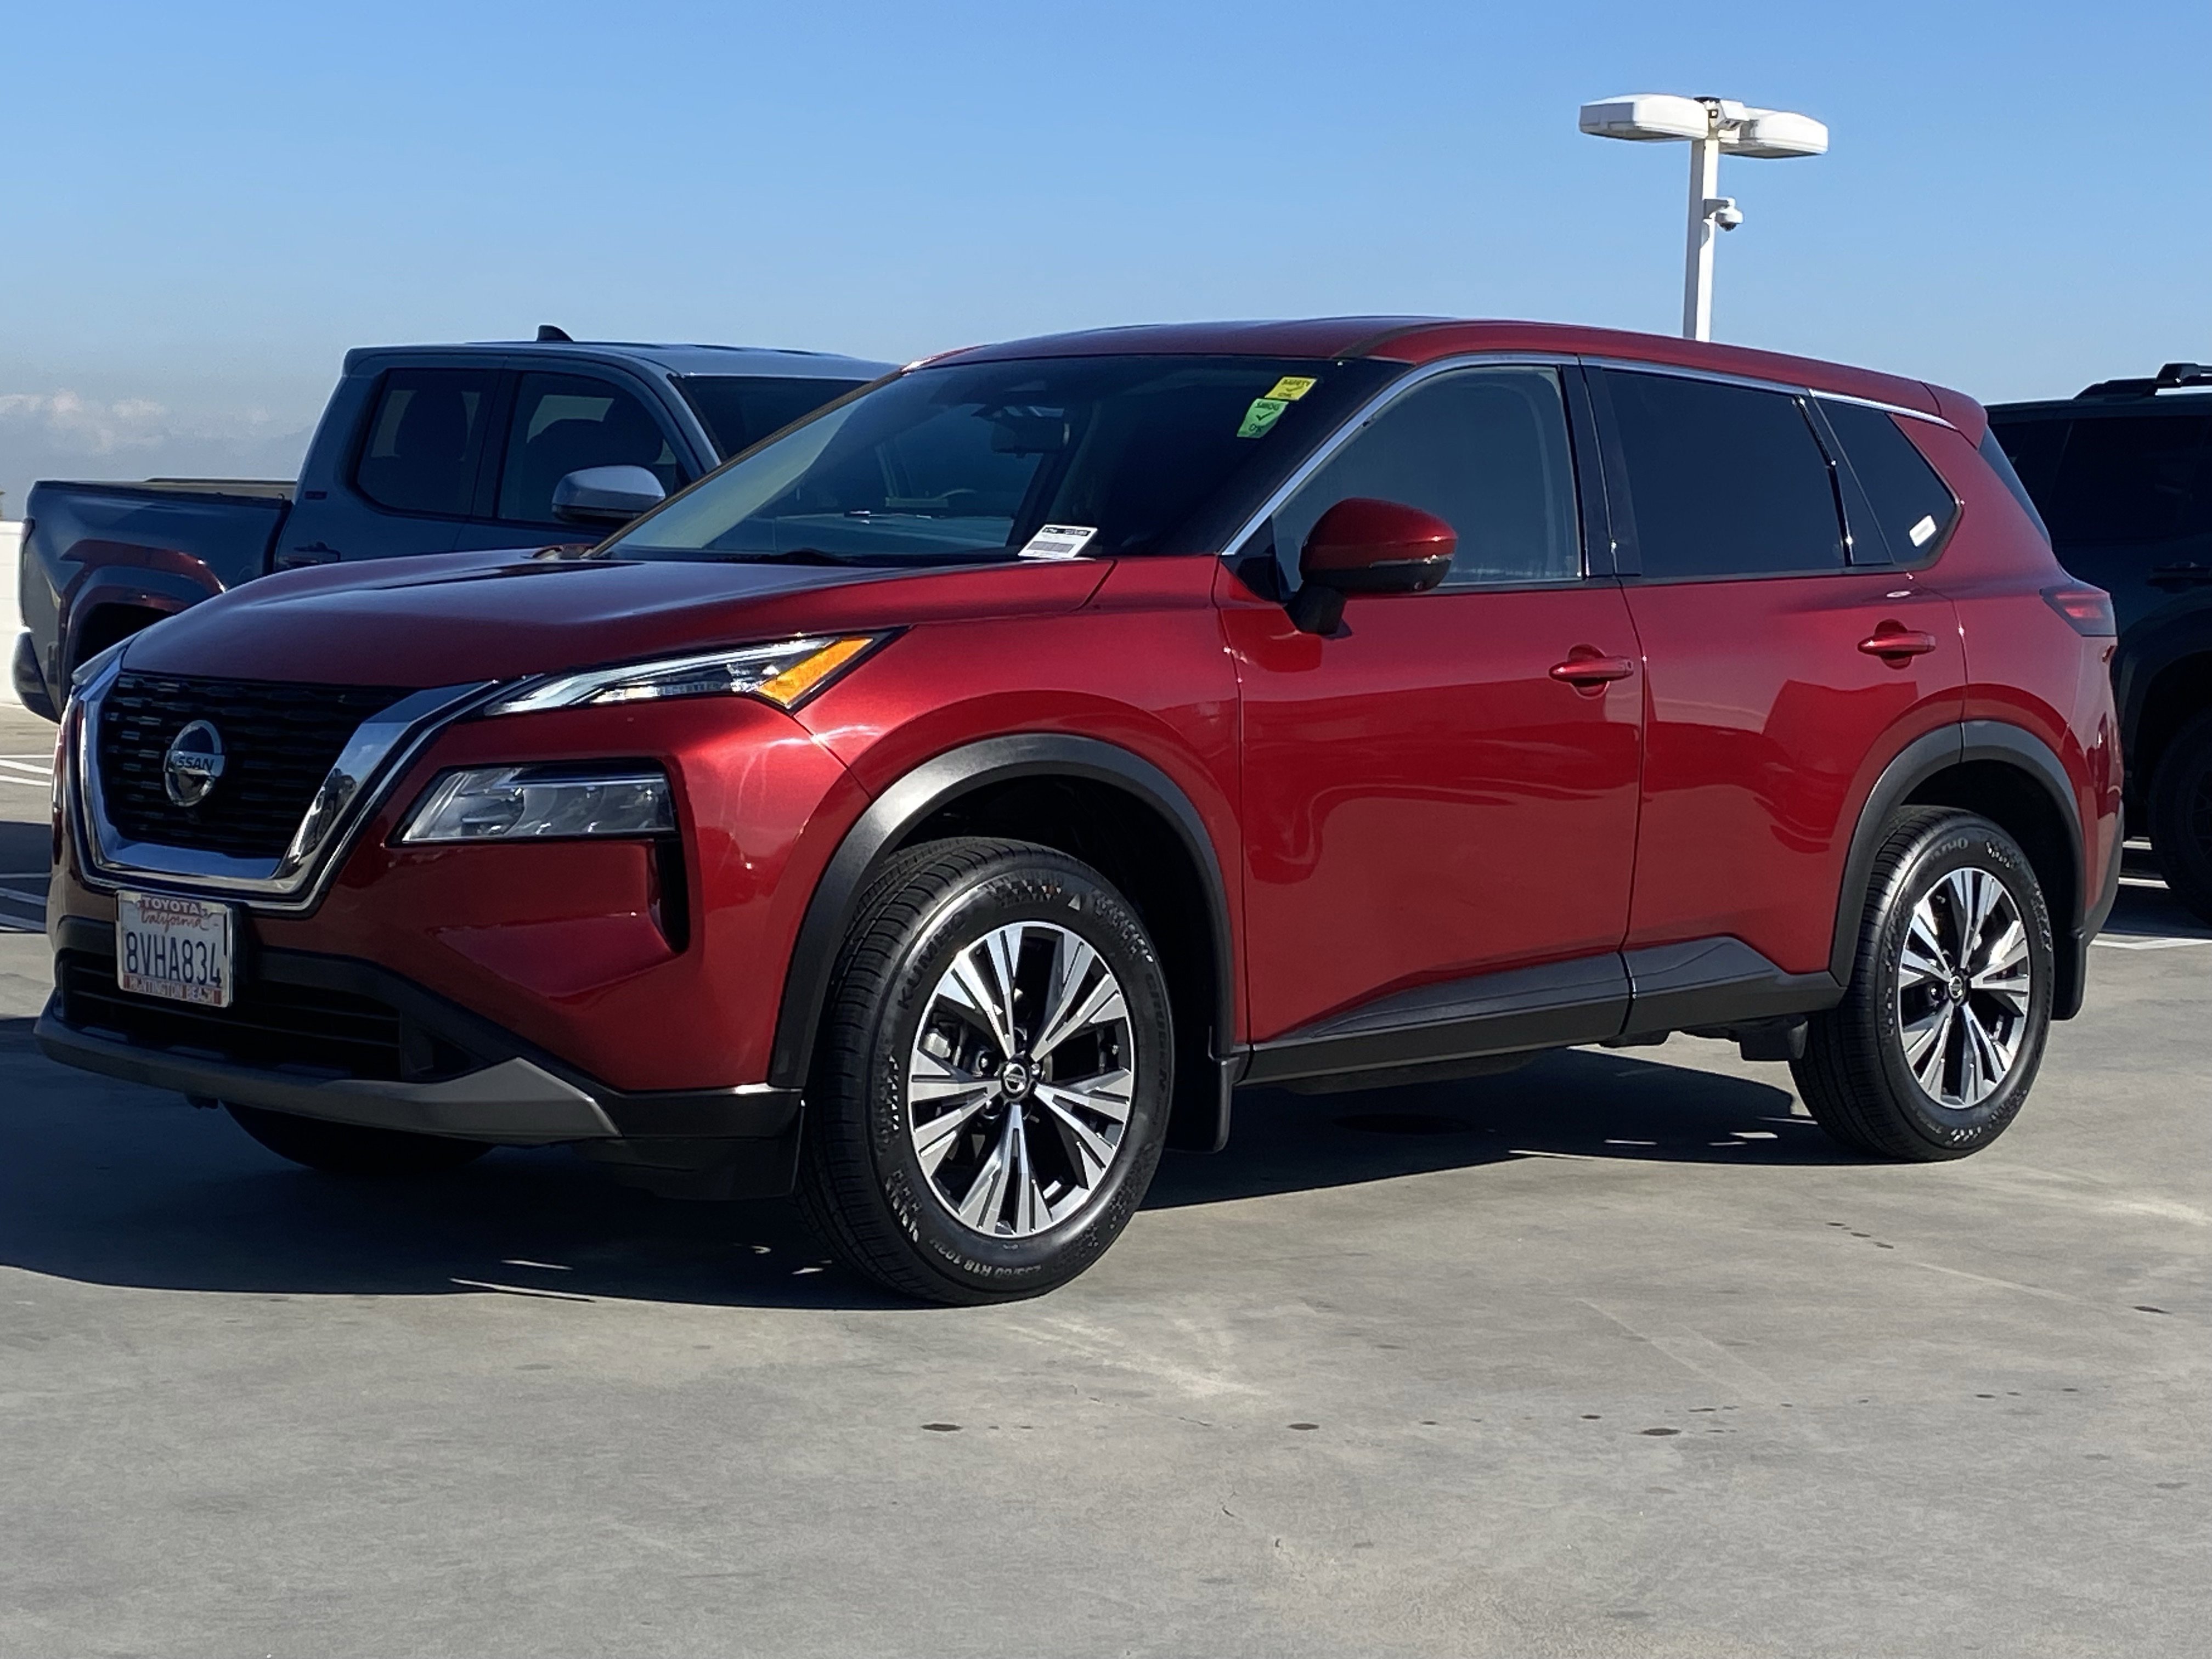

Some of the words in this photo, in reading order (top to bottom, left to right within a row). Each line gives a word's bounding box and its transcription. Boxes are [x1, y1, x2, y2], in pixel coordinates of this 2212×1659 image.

[169, 755, 215, 775] SSAN
[143, 896, 200, 913] TOYOTA
[140, 910, 209, 933] California
[126, 932, 222, 987] 8VHA834
[898, 911, 967, 1010] KUMHO
[963, 1259, 992, 1277] R18
